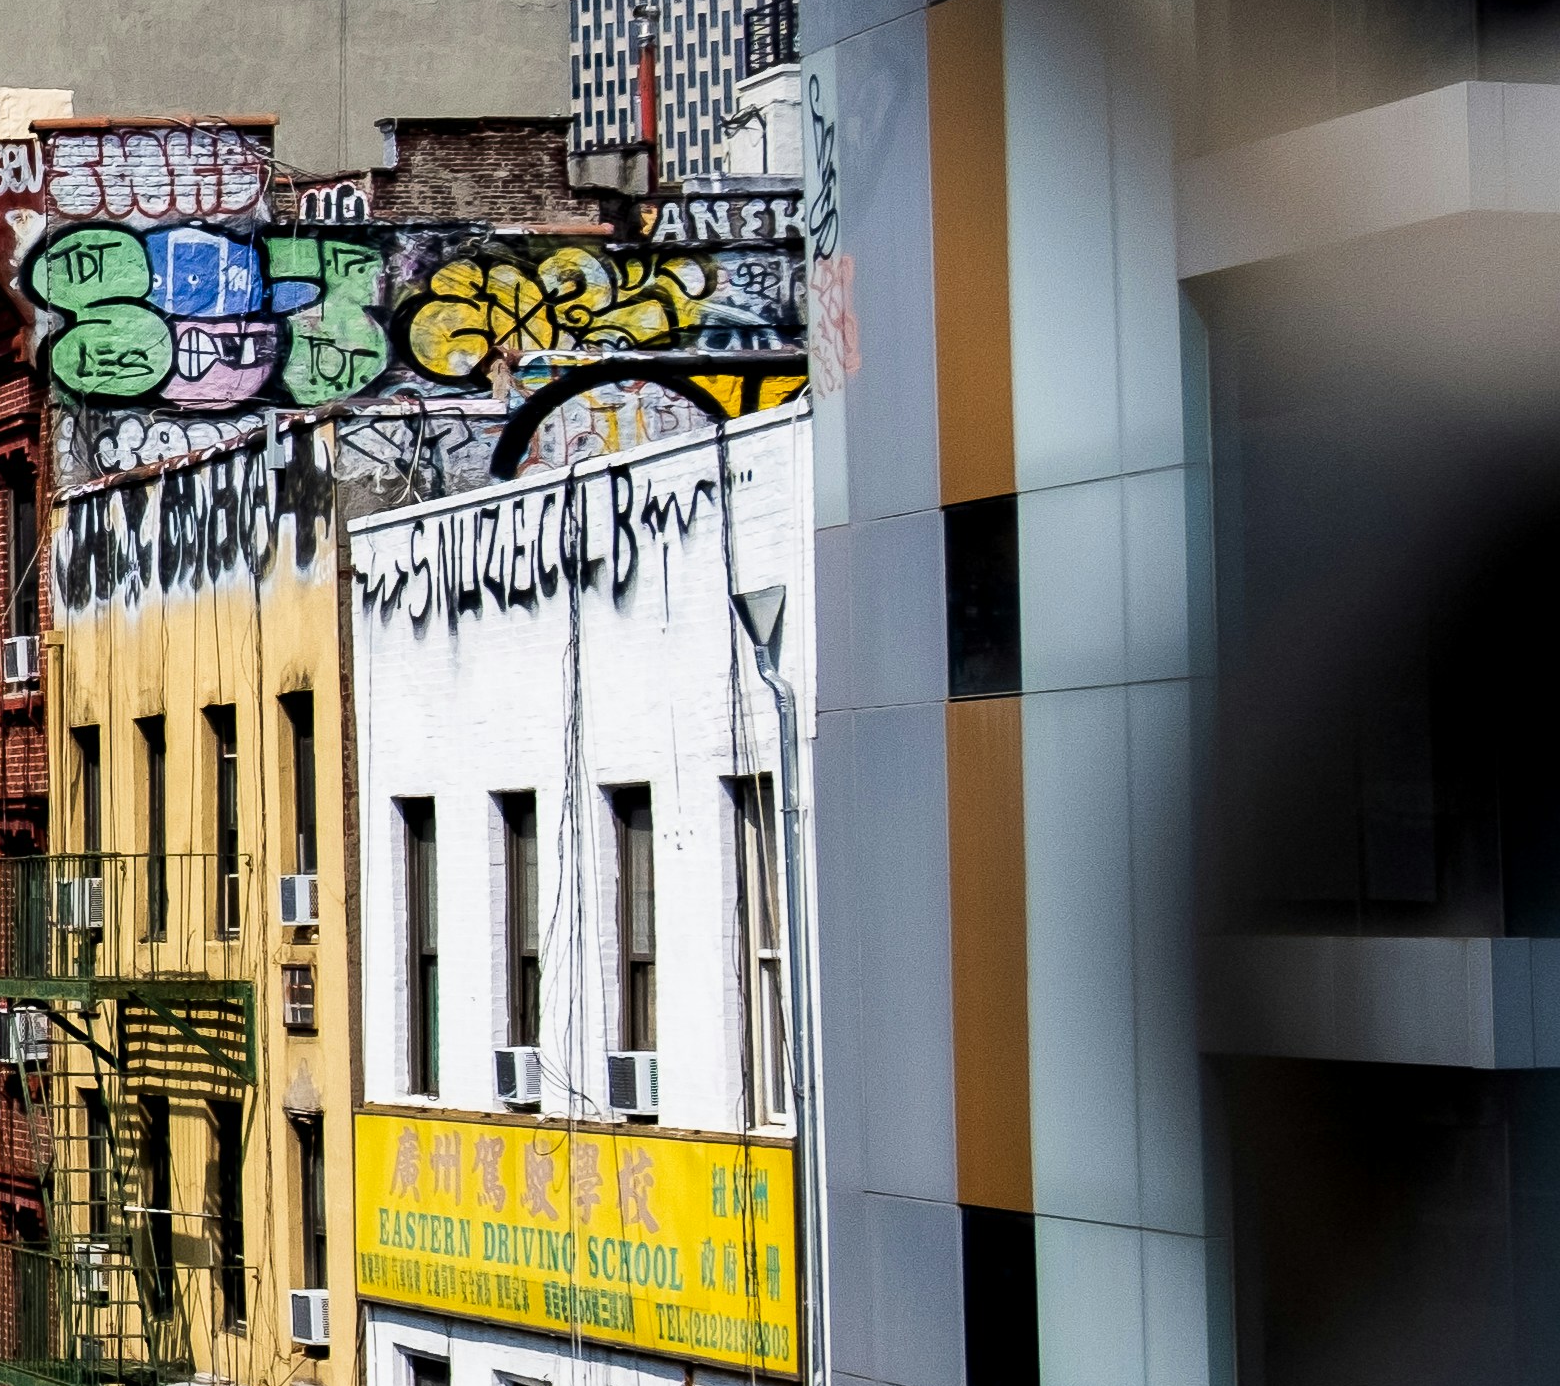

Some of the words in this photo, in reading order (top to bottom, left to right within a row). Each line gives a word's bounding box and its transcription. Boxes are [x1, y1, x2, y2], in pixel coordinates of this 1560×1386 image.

[389, 1126, 661, 1234] 廣州駕駛學校
[379, 1208, 471, 1259] EASTERN
[483, 1221, 575, 1275] DRIVING
[587, 1235, 684, 1291] SCHOOL
